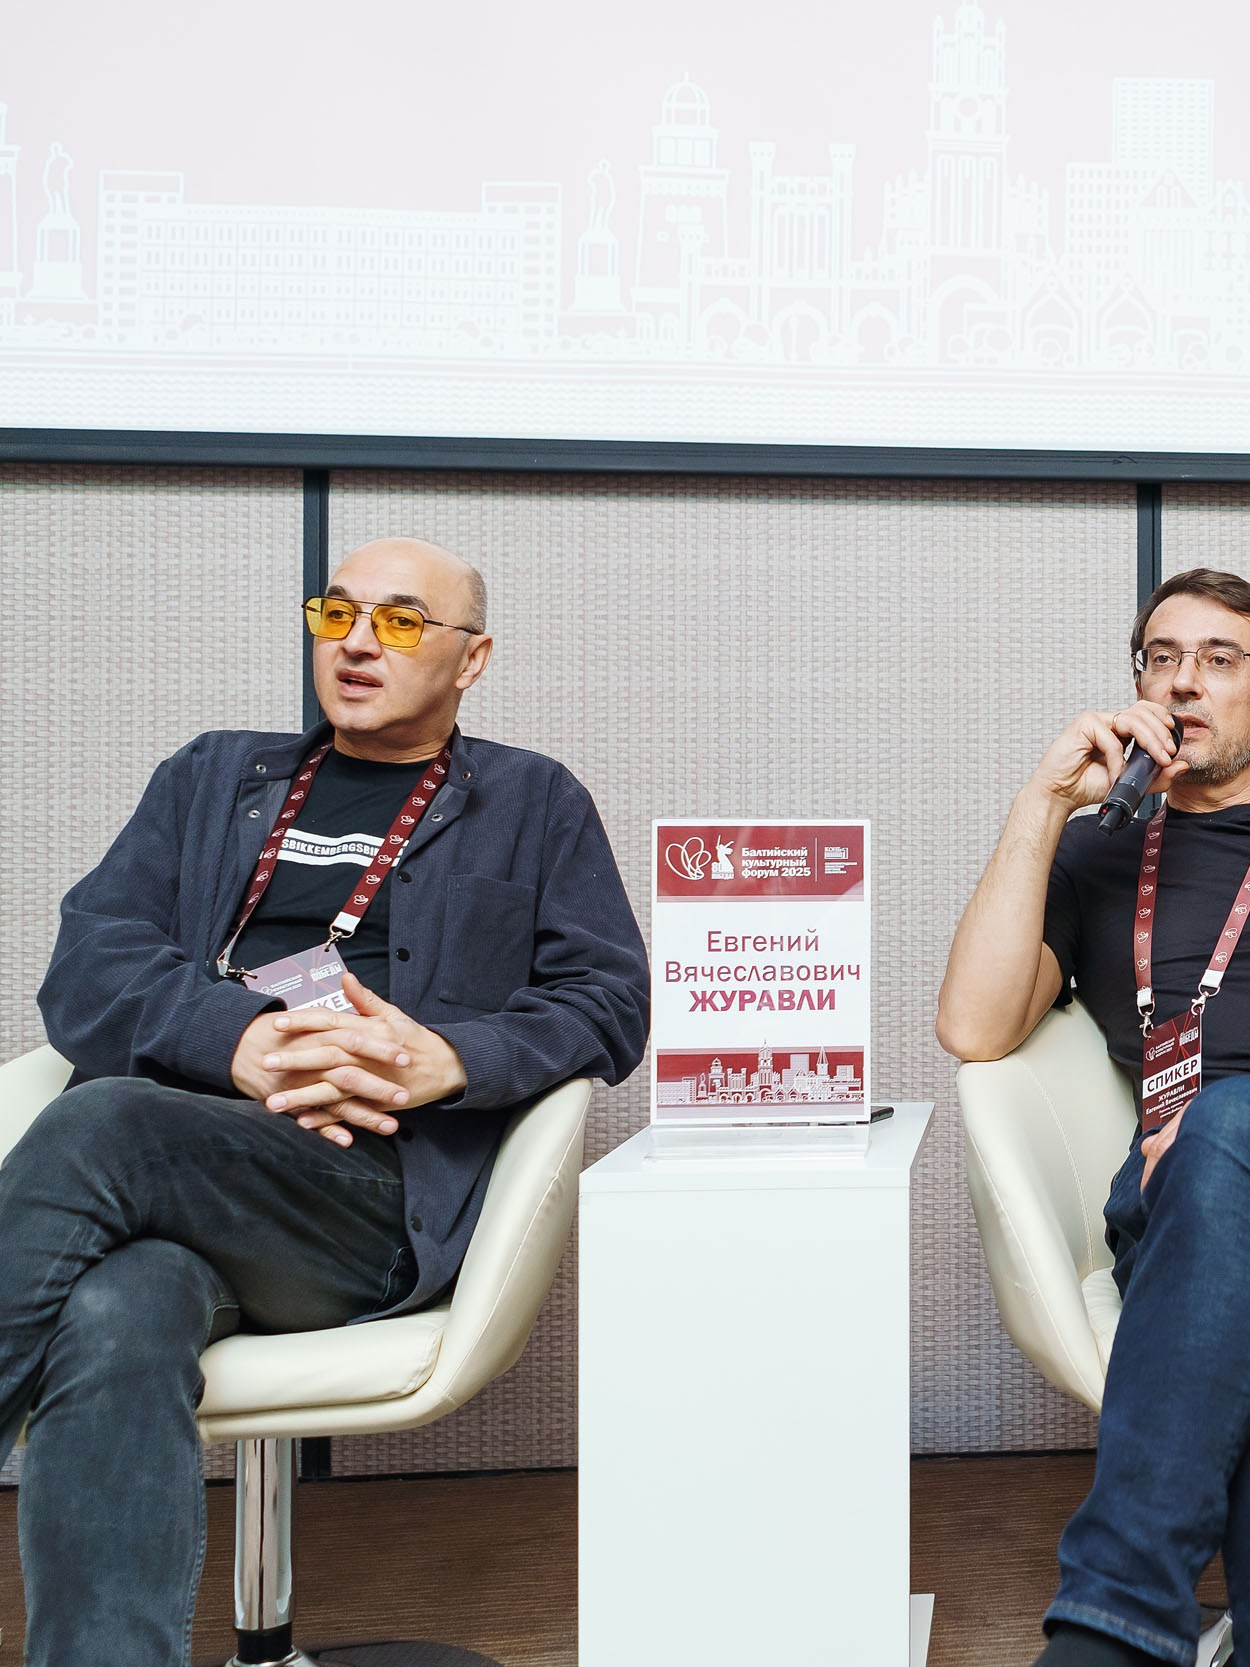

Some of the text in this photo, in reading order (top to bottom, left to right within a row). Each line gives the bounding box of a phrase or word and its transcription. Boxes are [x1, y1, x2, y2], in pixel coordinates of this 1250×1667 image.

[742, 846, 808, 857] Балтийский
[742, 857, 807, 868] культурный
[742, 867, 811, 879] форум 2025
[707, 928, 819, 952] Евгений
[665, 960, 861, 983] Вячеславович
[689, 989, 836, 1012] ЖУРАВЛИ
[1147, 1059, 1198, 1092] СПИКЕР
